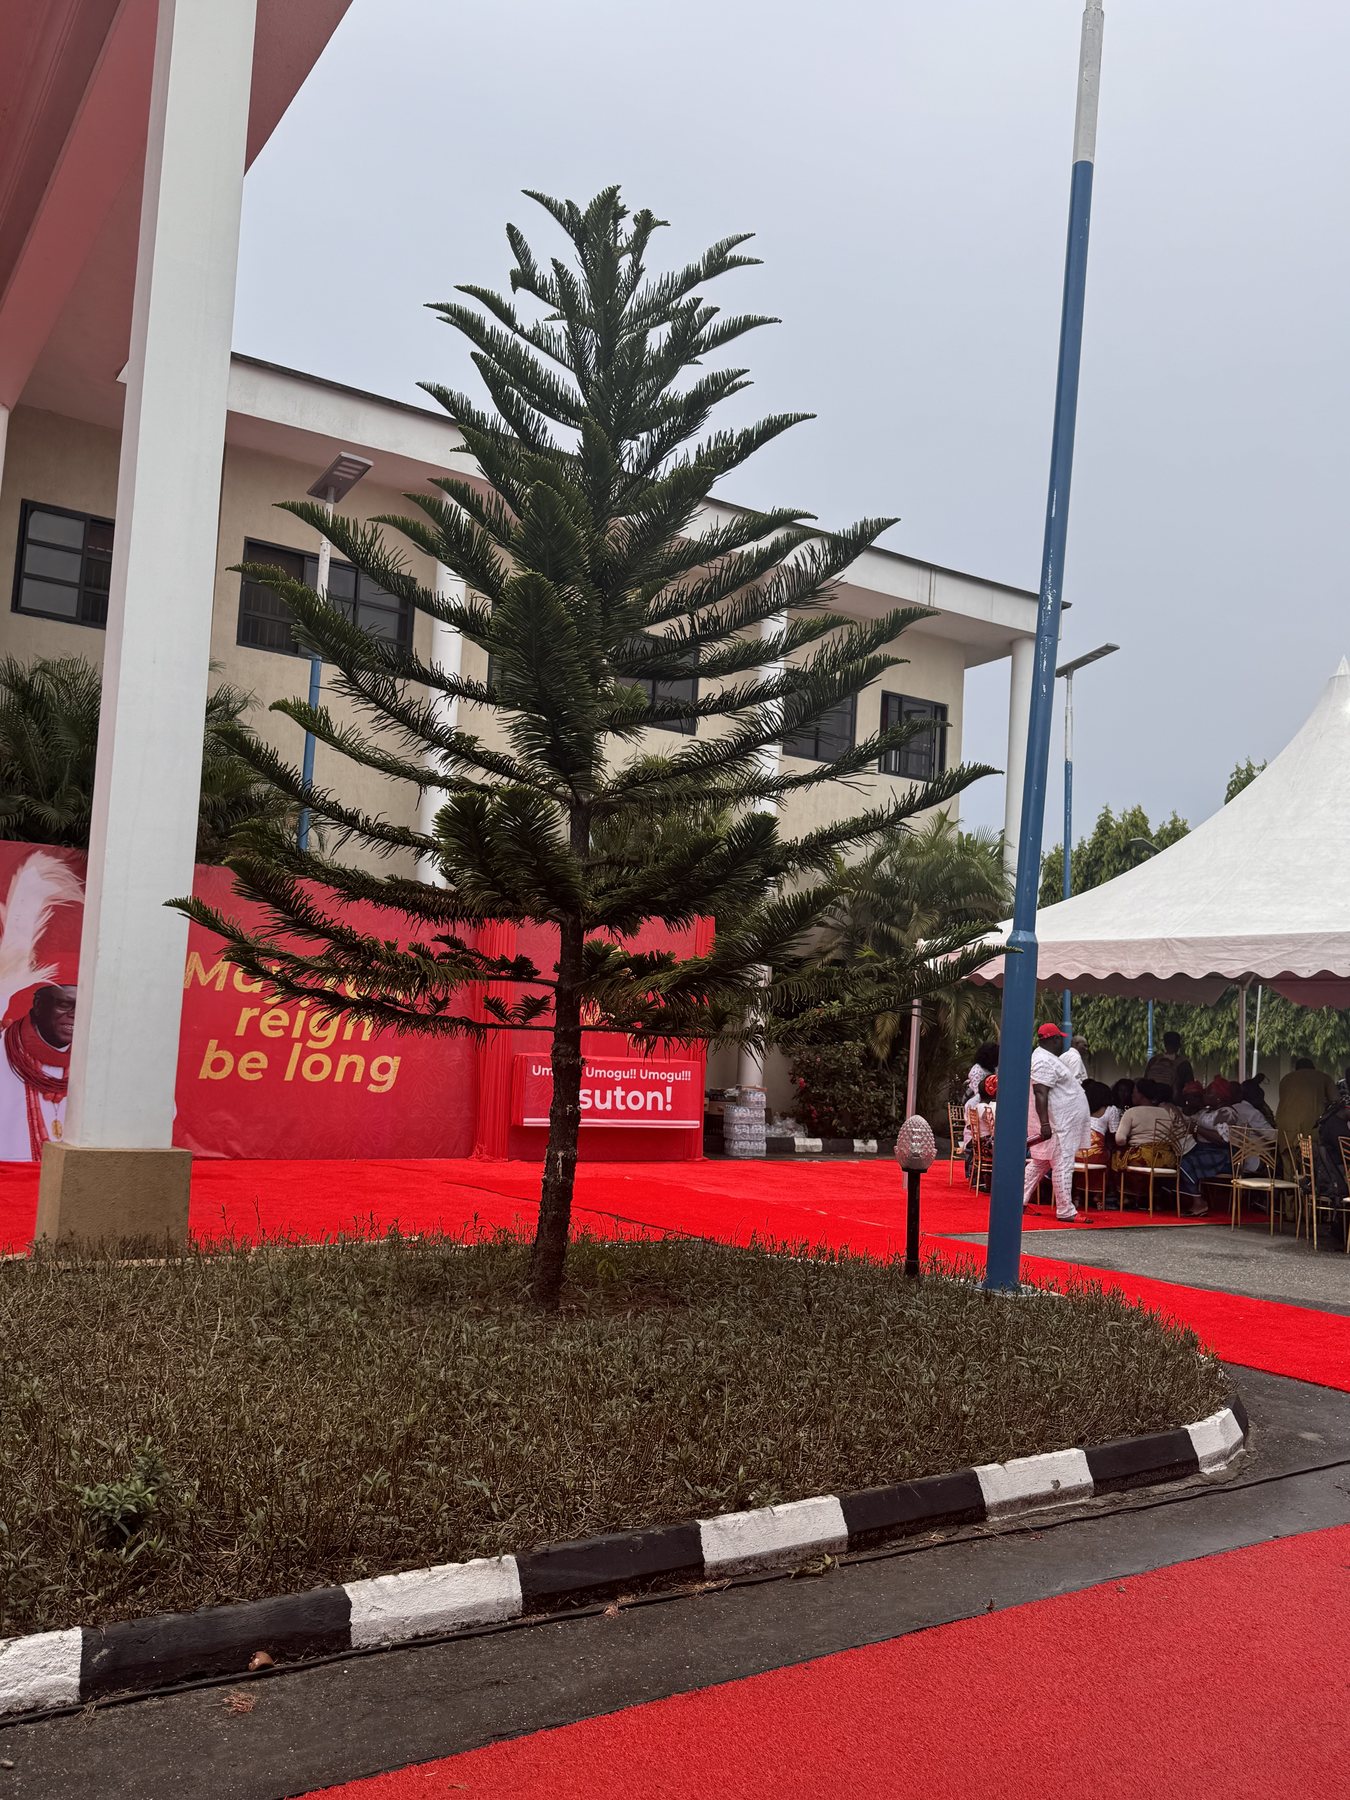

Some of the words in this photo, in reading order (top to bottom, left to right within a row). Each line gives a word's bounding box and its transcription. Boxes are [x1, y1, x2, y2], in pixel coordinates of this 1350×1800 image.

[234, 1001, 374, 1050] reign
[198, 1039, 269, 1081] be
[284, 1042, 402, 1093] long
[585, 1066, 637, 1081] Umogu!!
[639, 1068, 692, 1083] Umogu!!!
[579, 1086, 673, 1112] suton!
